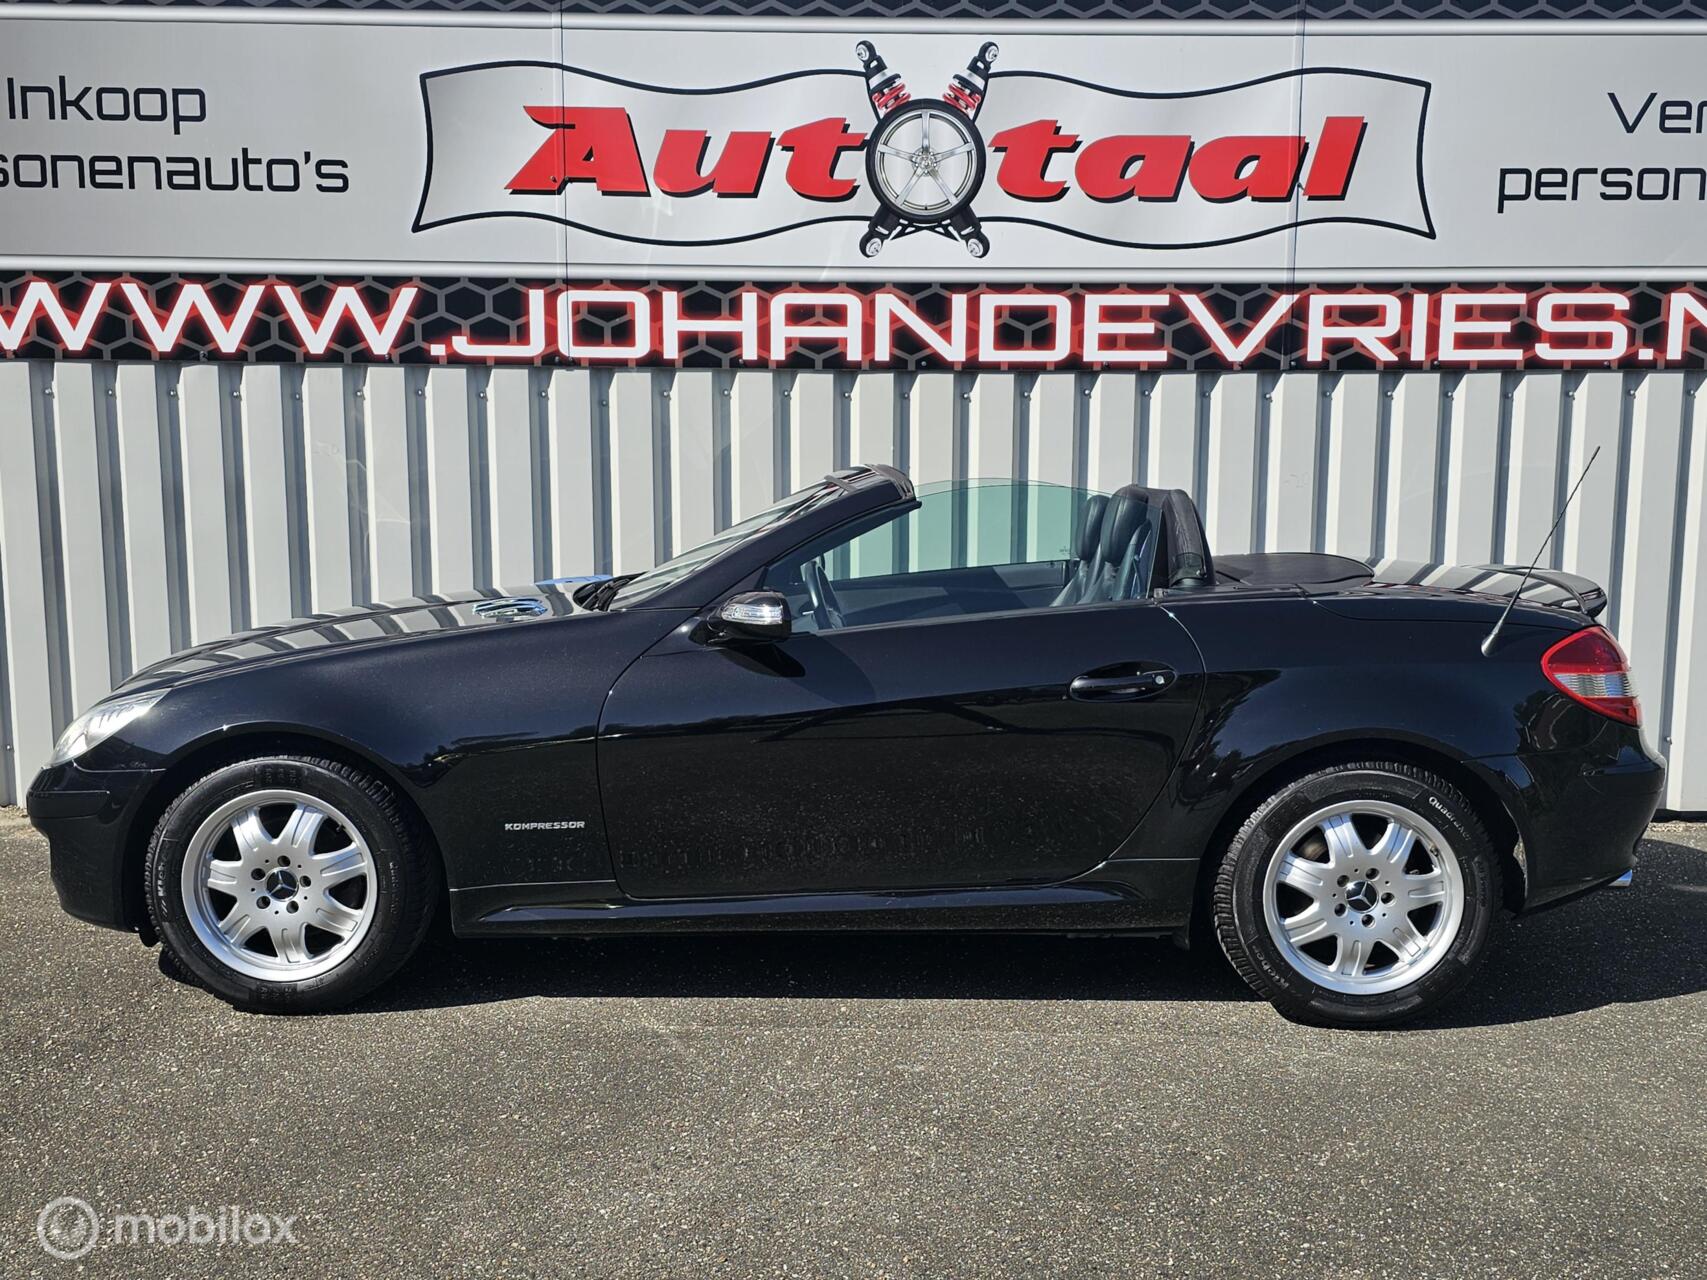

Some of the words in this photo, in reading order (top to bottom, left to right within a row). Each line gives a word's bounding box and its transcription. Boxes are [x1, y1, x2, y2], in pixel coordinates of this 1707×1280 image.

[7, 75, 206, 134] Inkoop
[1498, 167, 1707, 213] person
[504, 821, 585, 830] KOMPRESSOR
